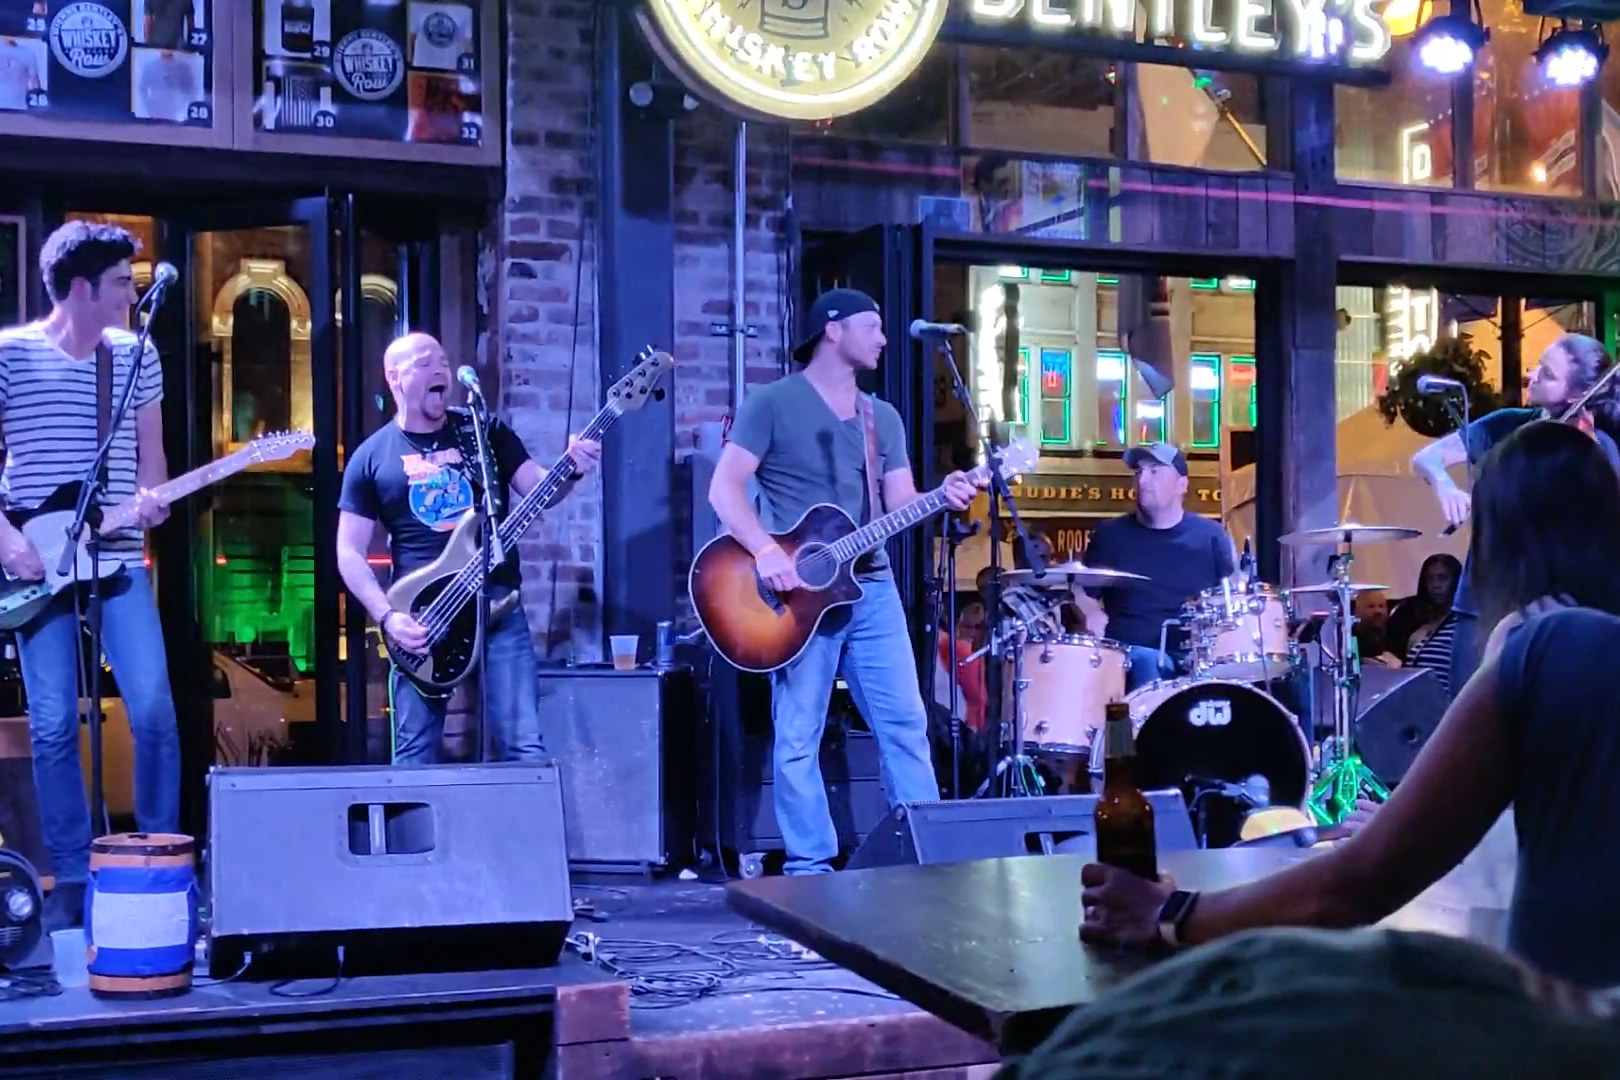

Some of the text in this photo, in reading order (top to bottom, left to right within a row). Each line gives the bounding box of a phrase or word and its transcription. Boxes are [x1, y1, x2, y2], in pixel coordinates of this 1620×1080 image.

[61, 29, 116, 48] WHISKEY
[190, 32, 207, 45] 27
[972, 0, 1389, 60] TLEY'S
[69, 47, 112, 70] Row
[343, 54, 393, 74] WHISKEY
[351, 72, 388, 94] Row
[316, 115, 334, 128] 30
[461, 127, 478, 139] 32
